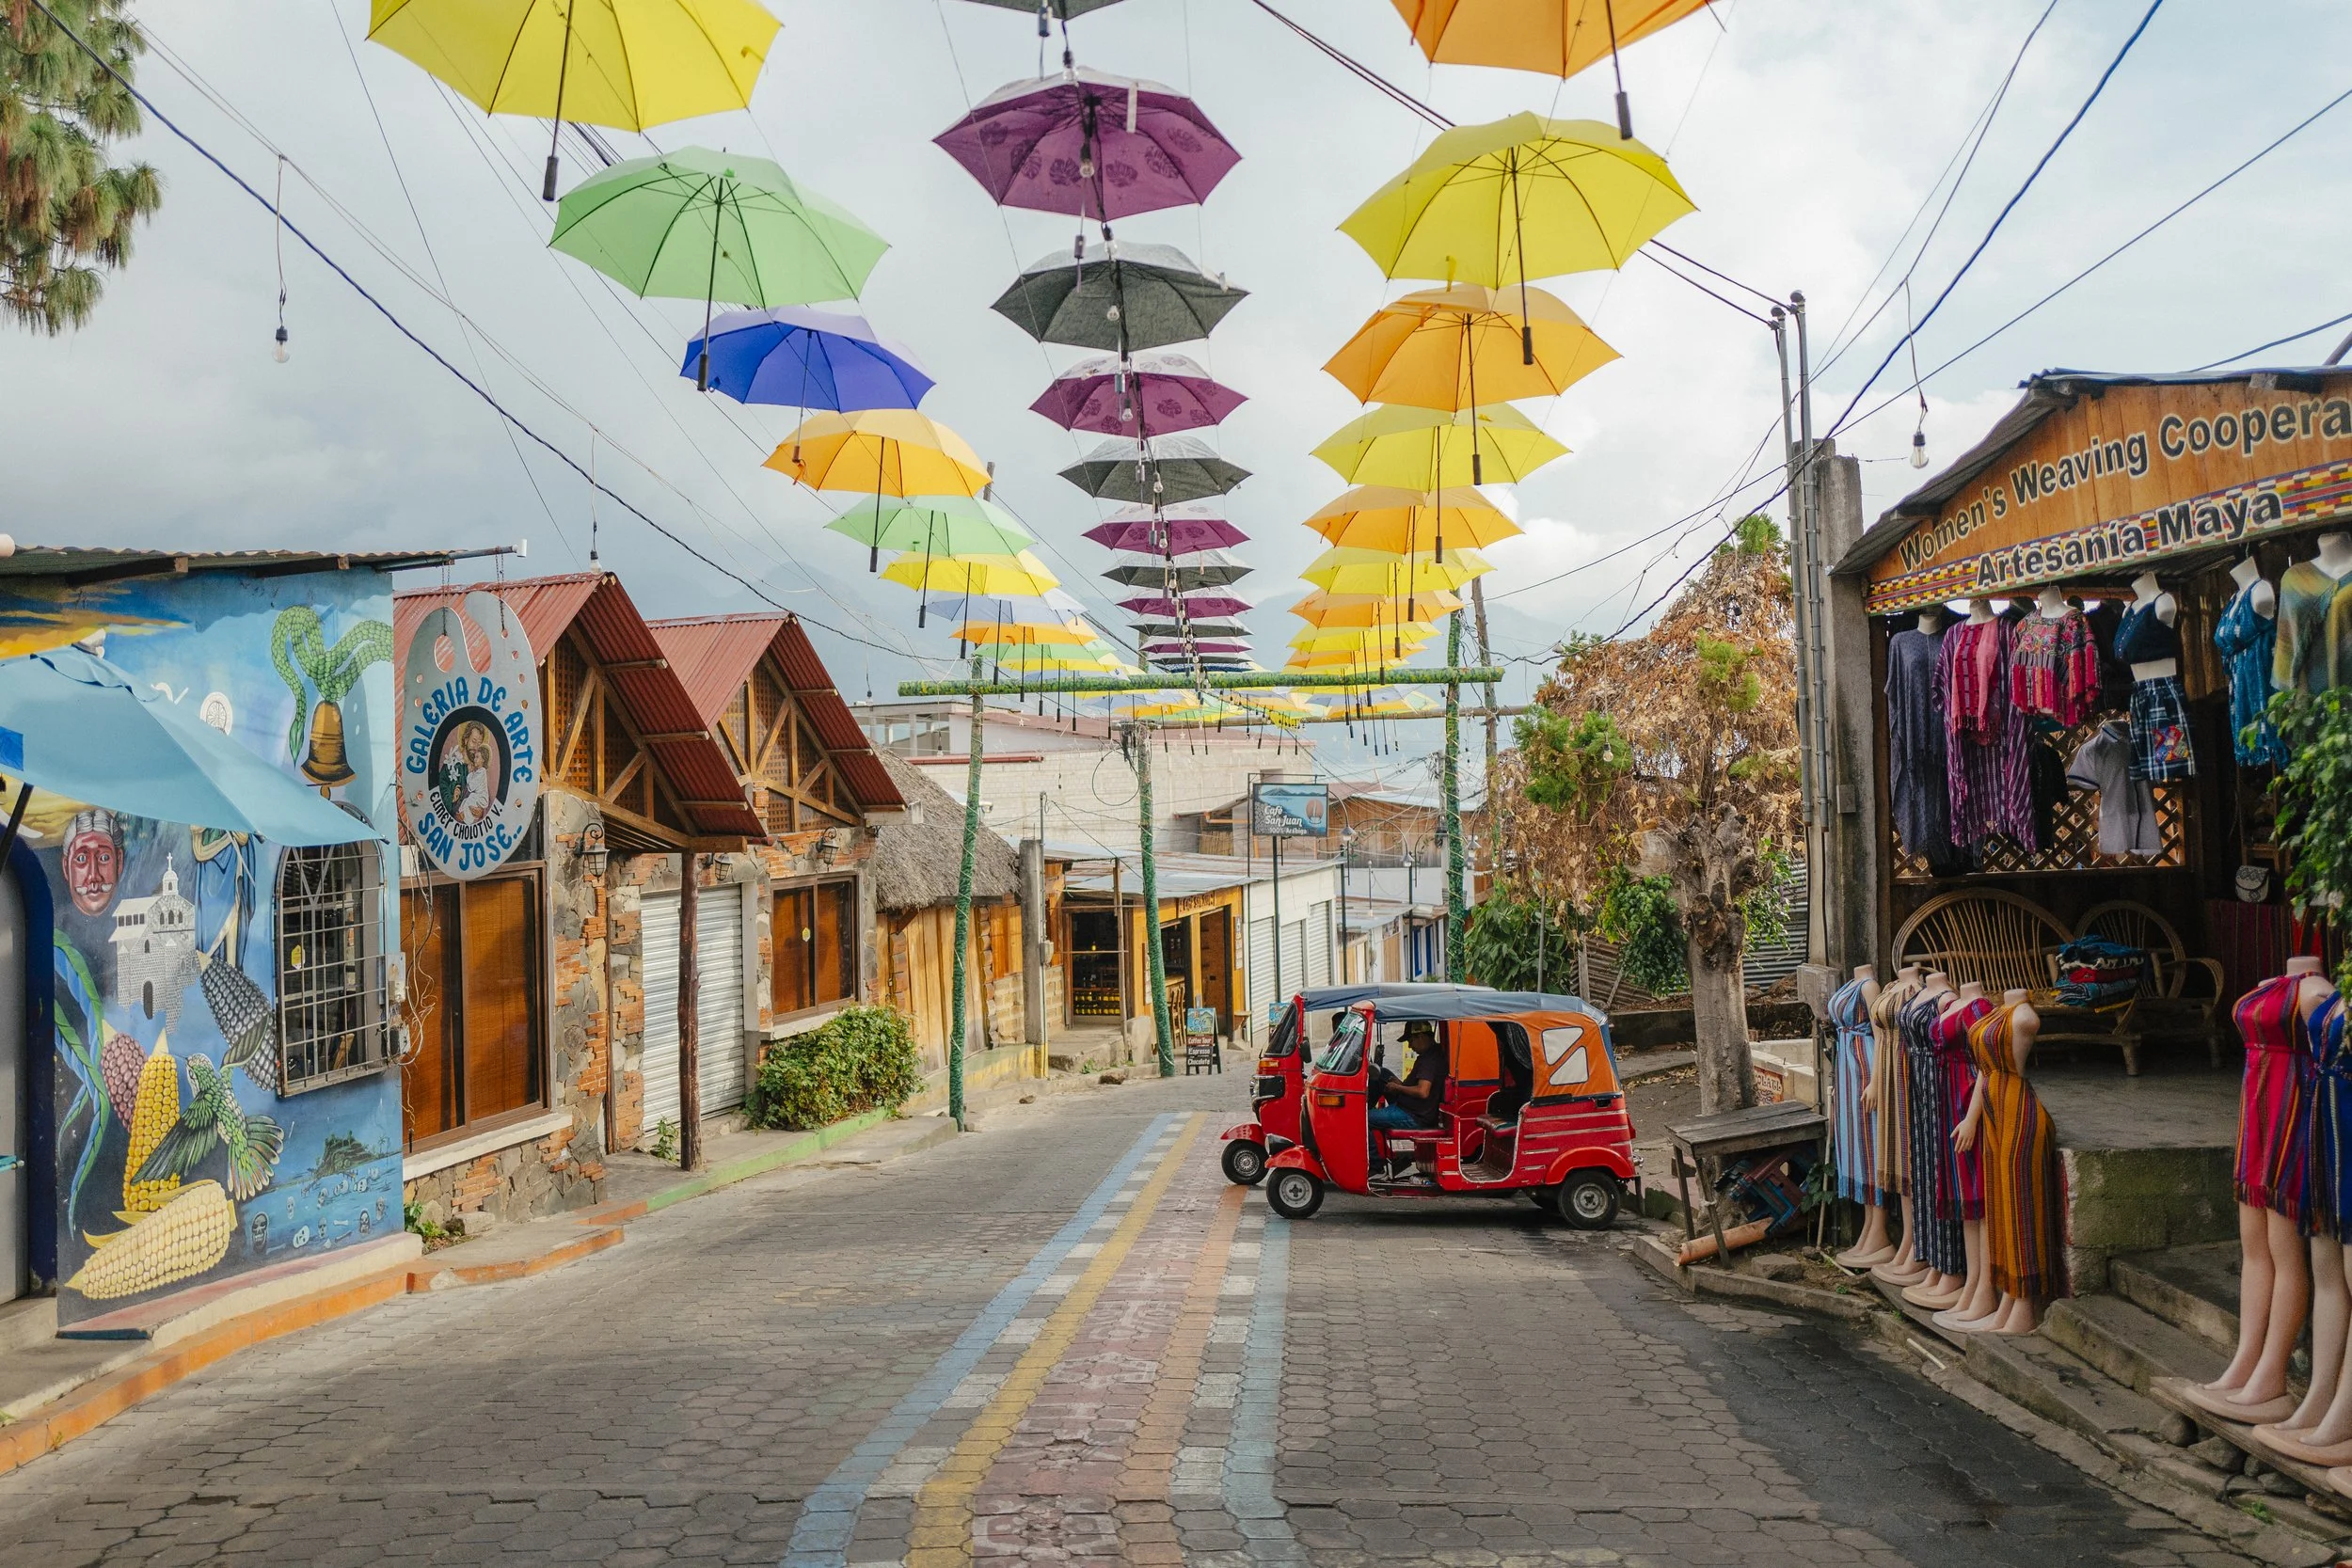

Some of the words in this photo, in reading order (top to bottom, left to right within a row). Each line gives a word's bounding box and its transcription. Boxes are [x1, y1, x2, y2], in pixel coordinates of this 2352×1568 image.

[1899, 485, 2008, 574] Women's
[2010, 431, 2150, 507] Weaving
[2158, 396, 2352, 461] Coopera
[1977, 520, 2148, 588] Artesanía
[2155, 490, 2283, 542] Maya
[405, 676, 469, 774] GALERIA
[476, 676, 507, 713] DE
[503, 711, 533, 784] ARTE
[418, 812, 454, 864] SAN
[1264, 805, 1282, 816] Café
[1265, 816, 1280, 827] San
[1281, 816, 1302, 827] Juan
